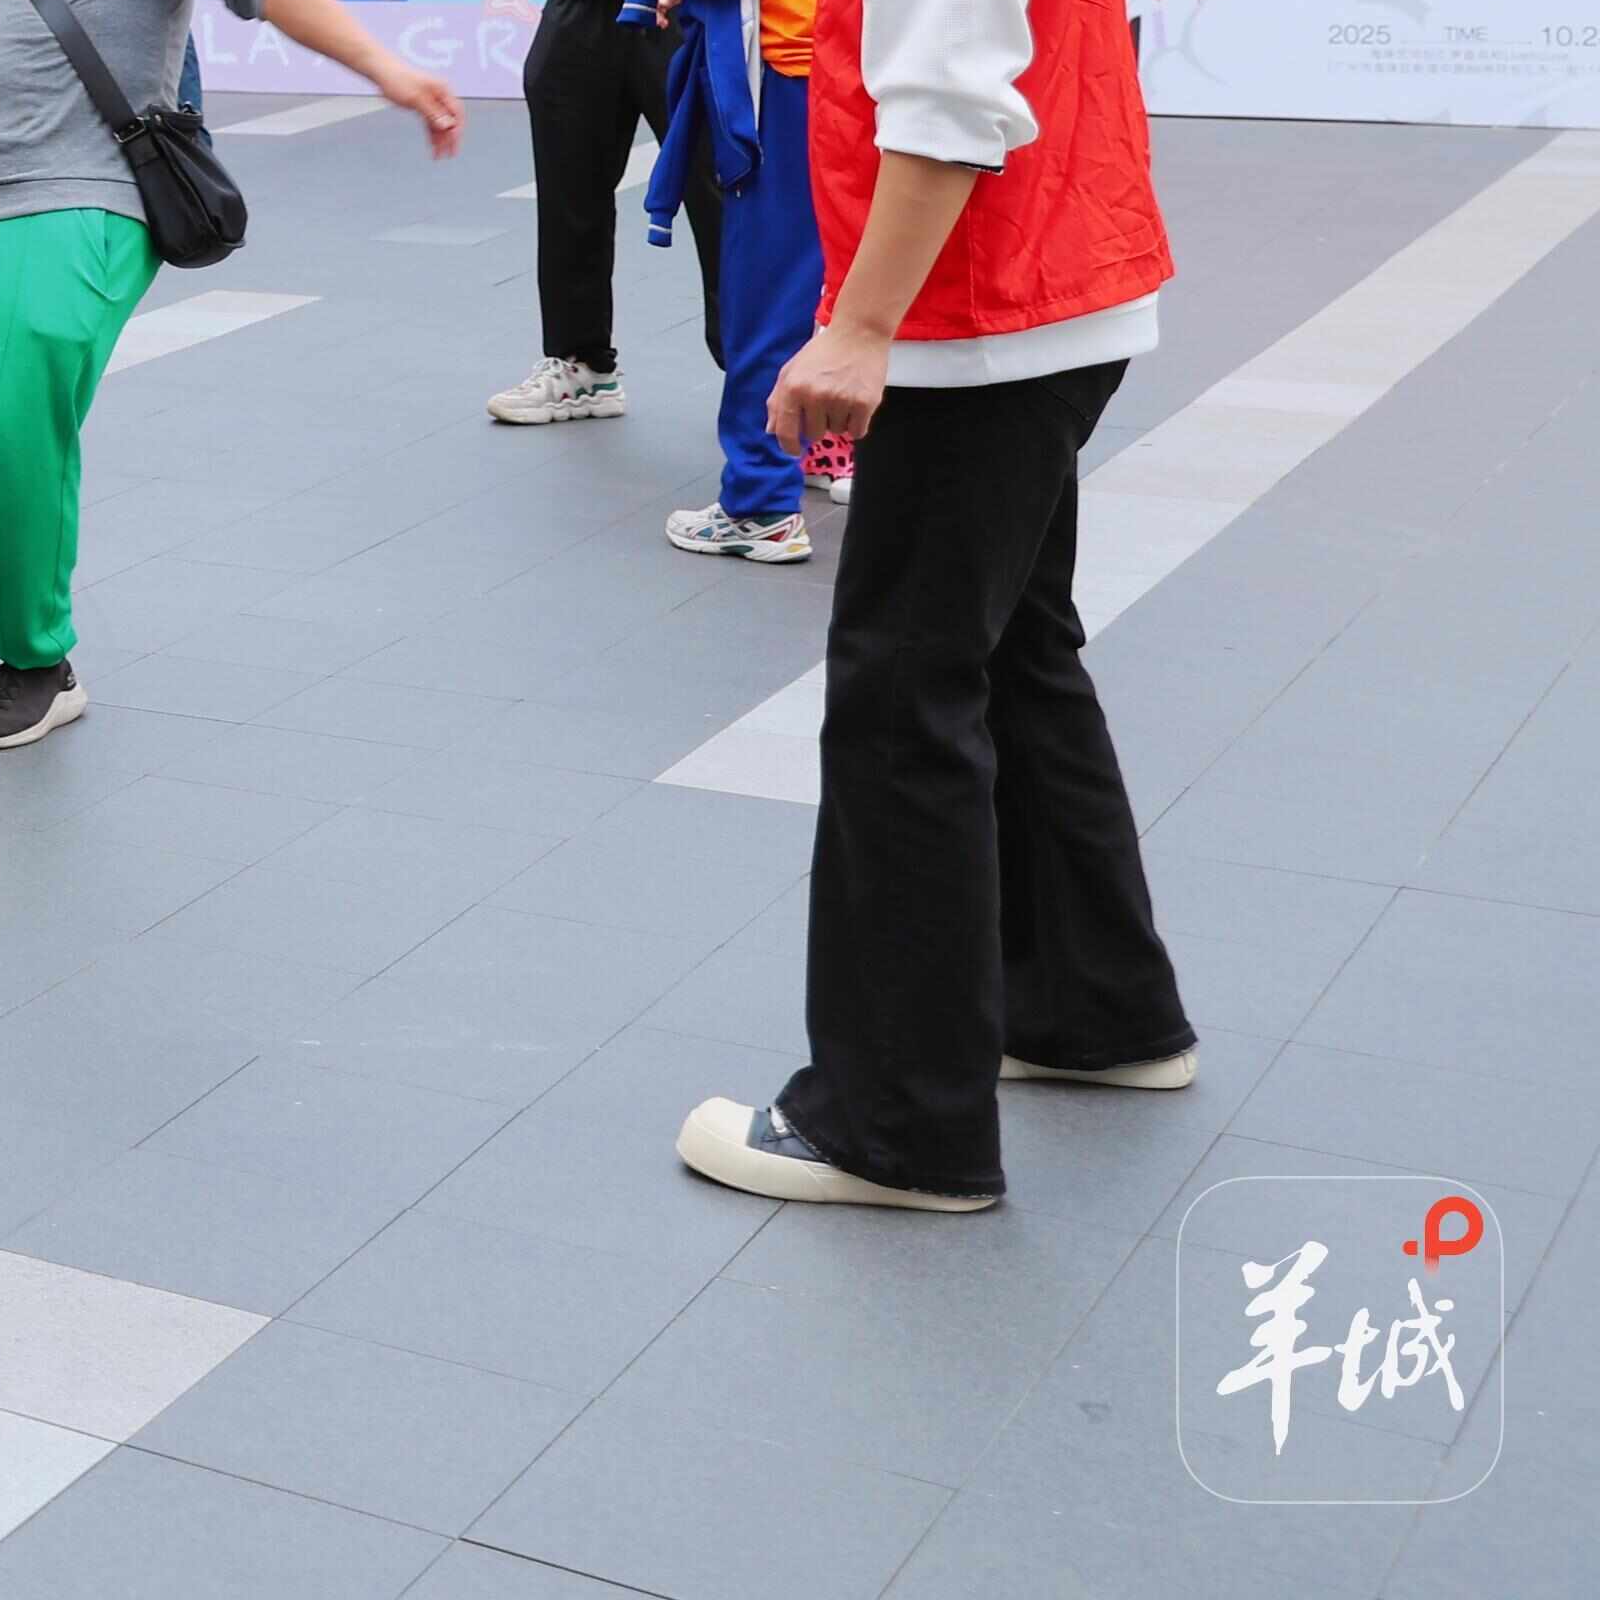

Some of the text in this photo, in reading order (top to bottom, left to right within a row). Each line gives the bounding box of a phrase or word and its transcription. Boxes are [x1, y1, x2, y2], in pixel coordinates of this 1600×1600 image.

[1328, 24, 1600, 47] 2025 TIME 10.2
